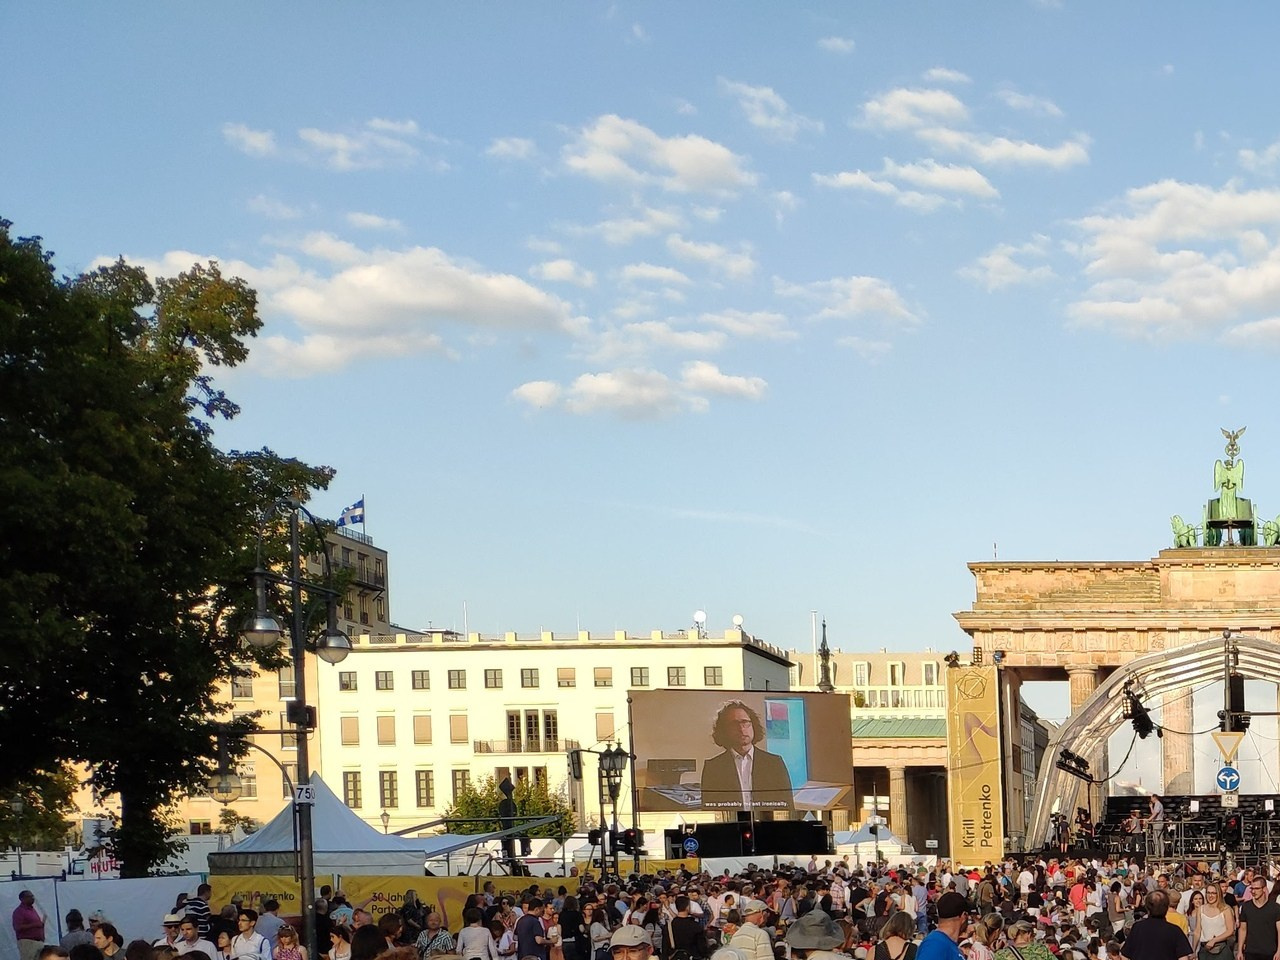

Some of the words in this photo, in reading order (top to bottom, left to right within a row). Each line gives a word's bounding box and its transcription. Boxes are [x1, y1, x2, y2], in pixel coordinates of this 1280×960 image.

[296, 787, 316, 800] 750
[718, 801, 742, 809] probably
[979, 784, 993, 848] Petrenko
[962, 819, 975, 848] Kirill
[372, 892, 384, 902] 30
